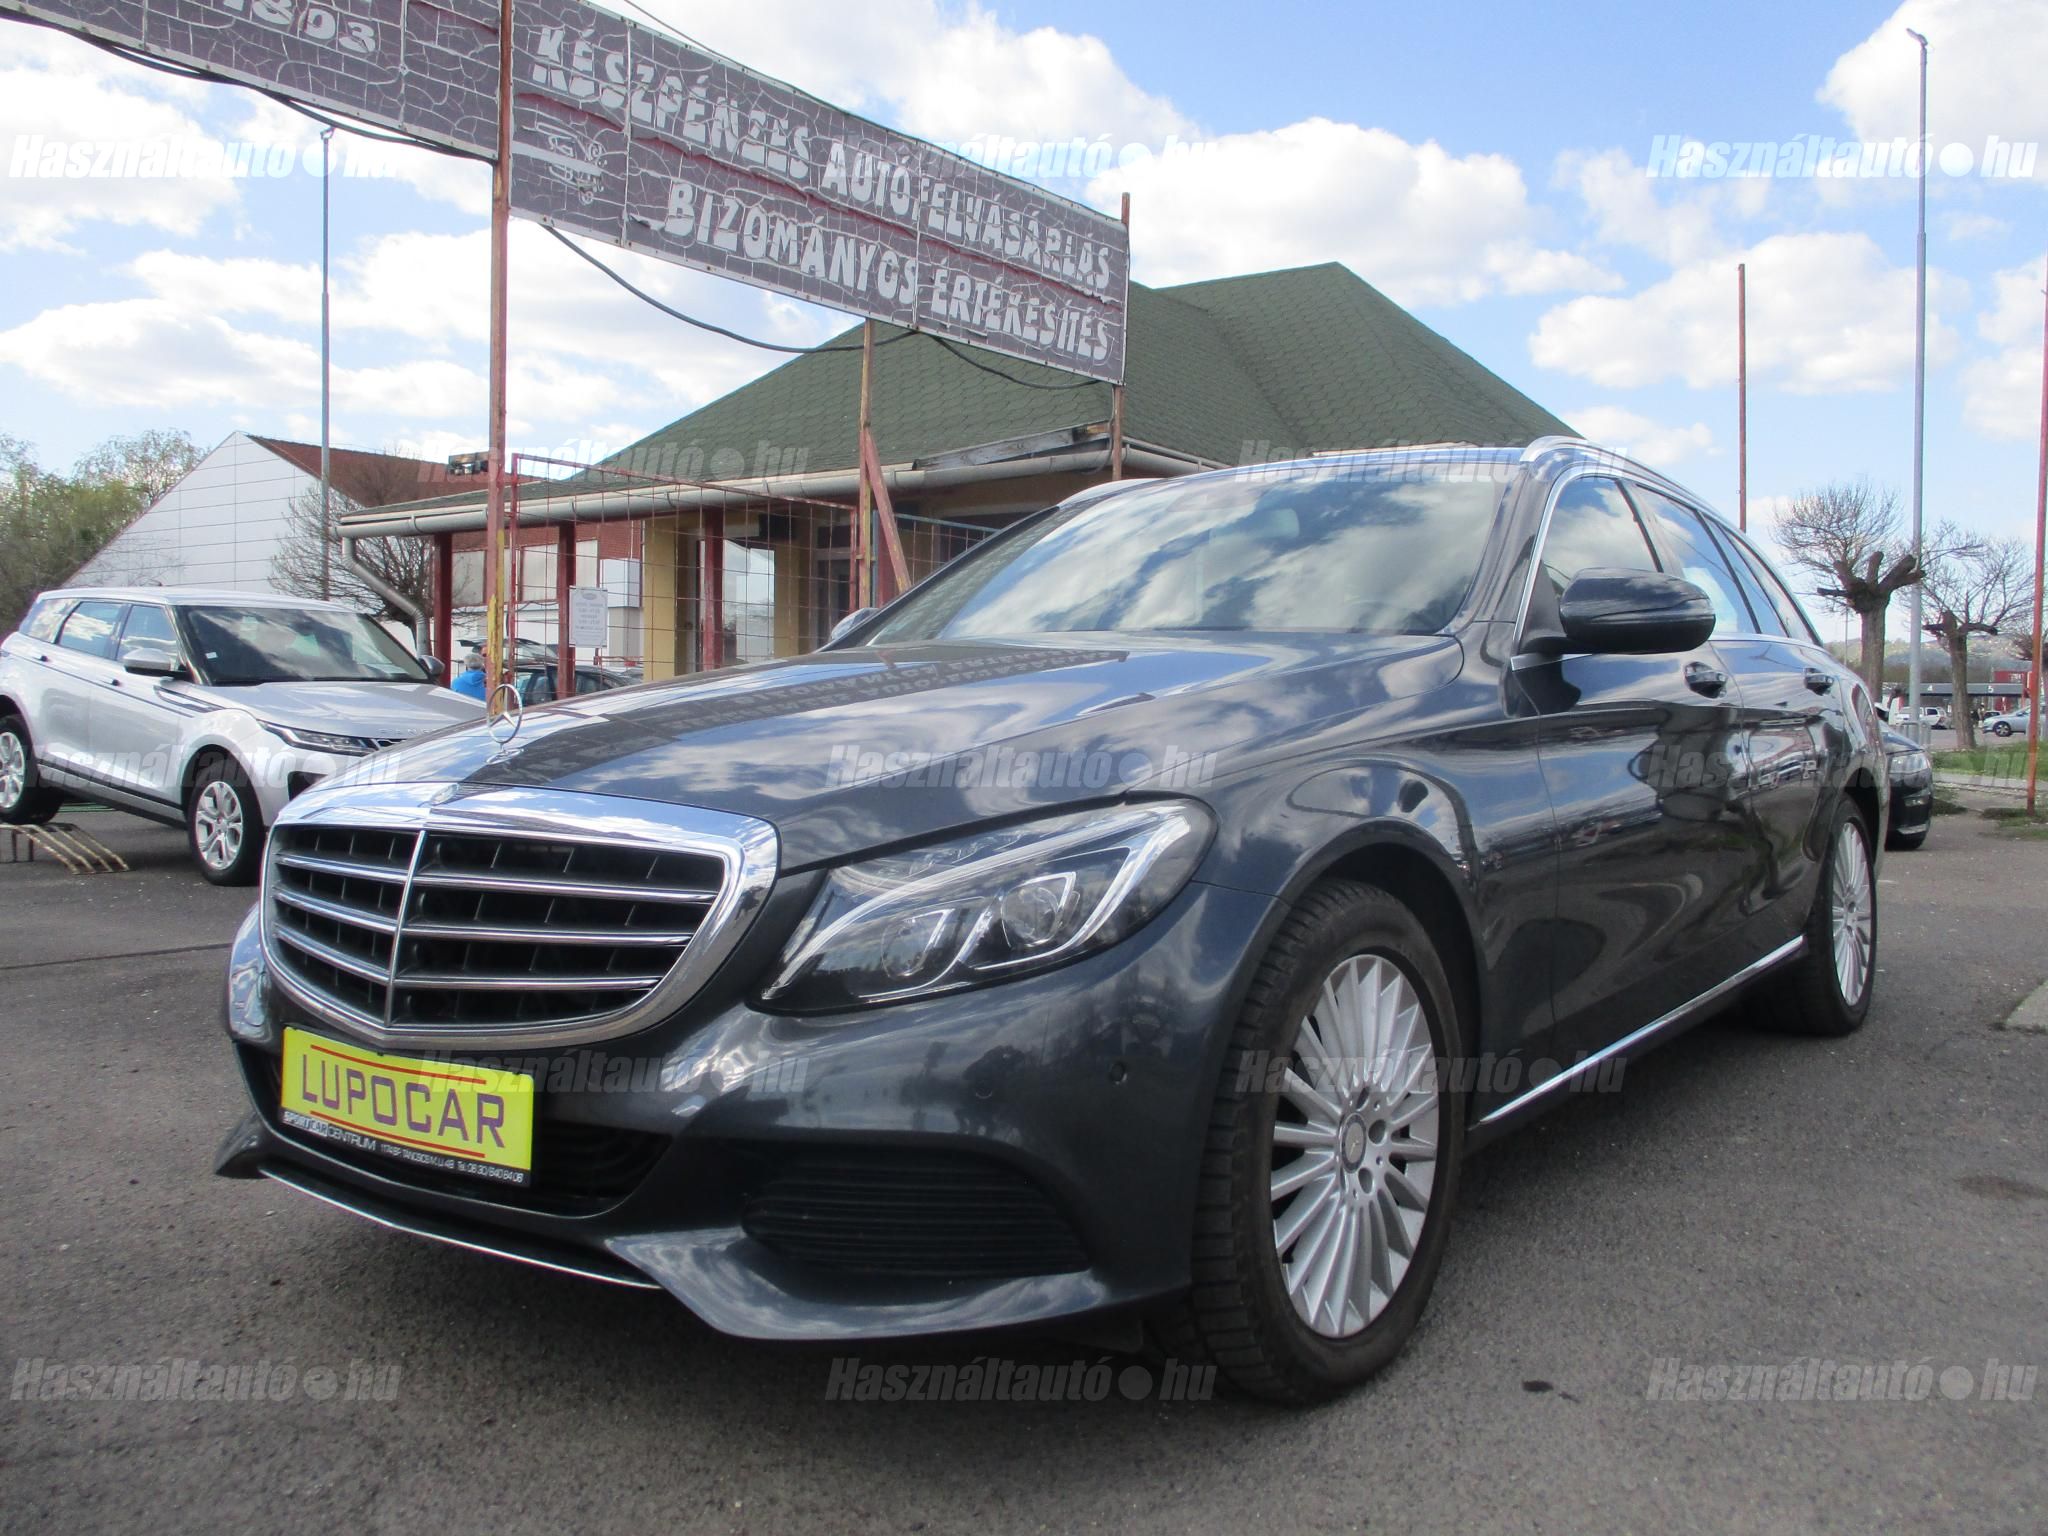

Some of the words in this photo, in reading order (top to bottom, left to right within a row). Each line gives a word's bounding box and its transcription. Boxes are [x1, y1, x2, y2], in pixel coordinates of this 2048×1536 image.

[532, 27, 809, 180] KÉSZPÉNZES
[664, 183, 916, 304] BIZOMÁNYOS
[931, 257, 1108, 360] ÉRTÉKESÍTÉS
[303, 1054, 505, 1148] LUPOCAR
